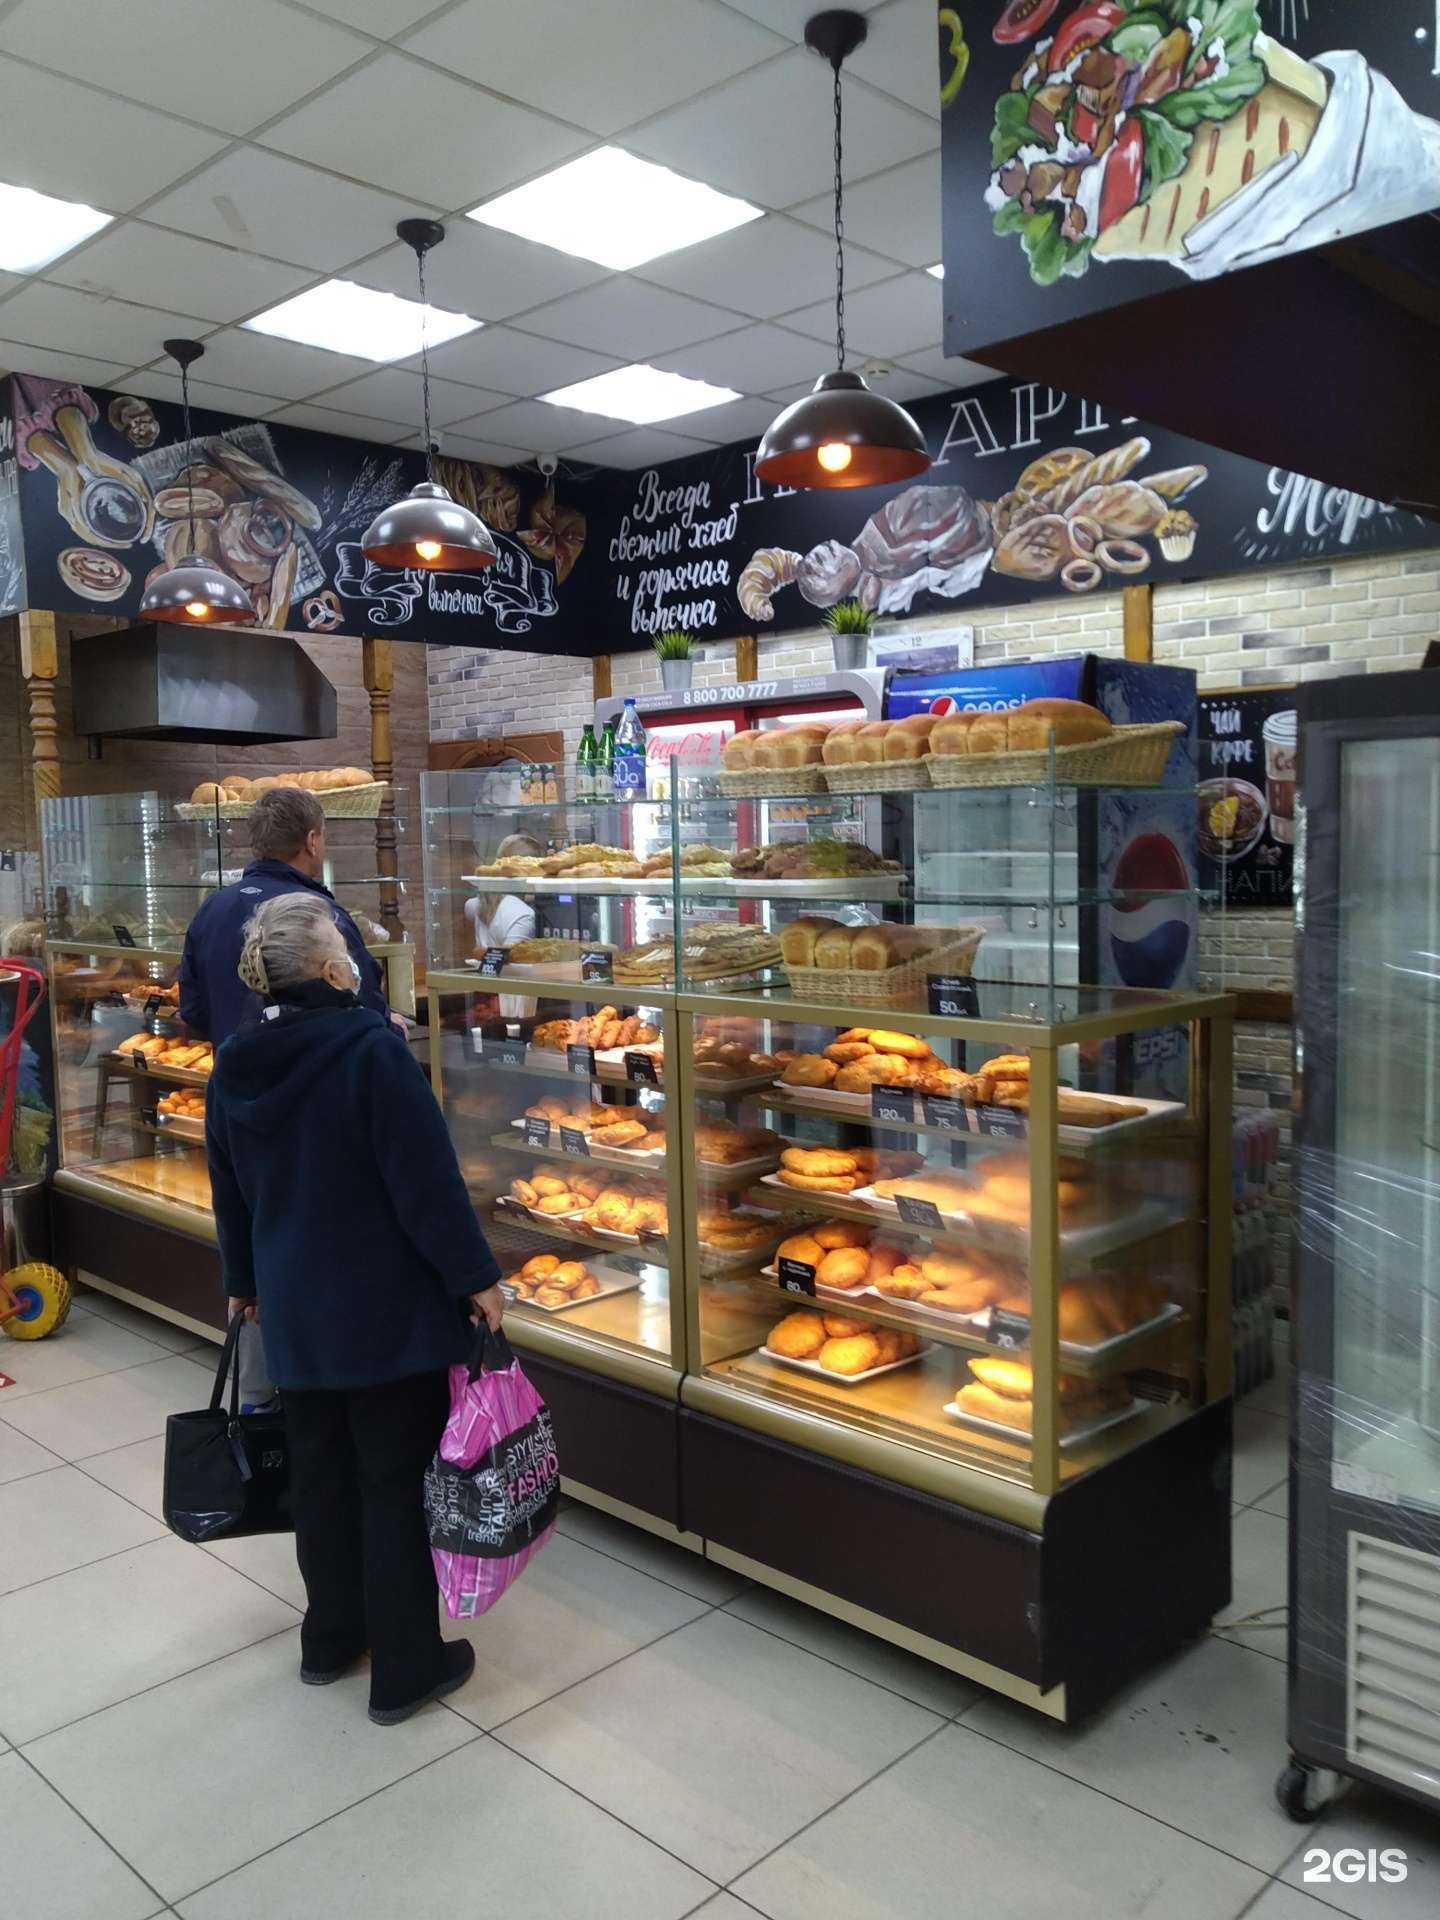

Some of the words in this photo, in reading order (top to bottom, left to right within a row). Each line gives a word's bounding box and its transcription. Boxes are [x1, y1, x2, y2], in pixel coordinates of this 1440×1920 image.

[633, 470, 711, 528] Всегда
[609, 515, 682, 562] свежий
[688, 502, 740, 549] хлеб
[428, 572, 484, 615] выпечка
[616, 574, 630, 600] и
[637, 558, 731, 608] горячая
[631, 590, 717, 634] выпечка
[683, 691, 691, 704] 8
[693, 688, 718, 704] 800
[720, 685, 745, 700] 700
[748, 681, 778, 698] 7777
[507, 1451, 559, 1506] FASHIO
